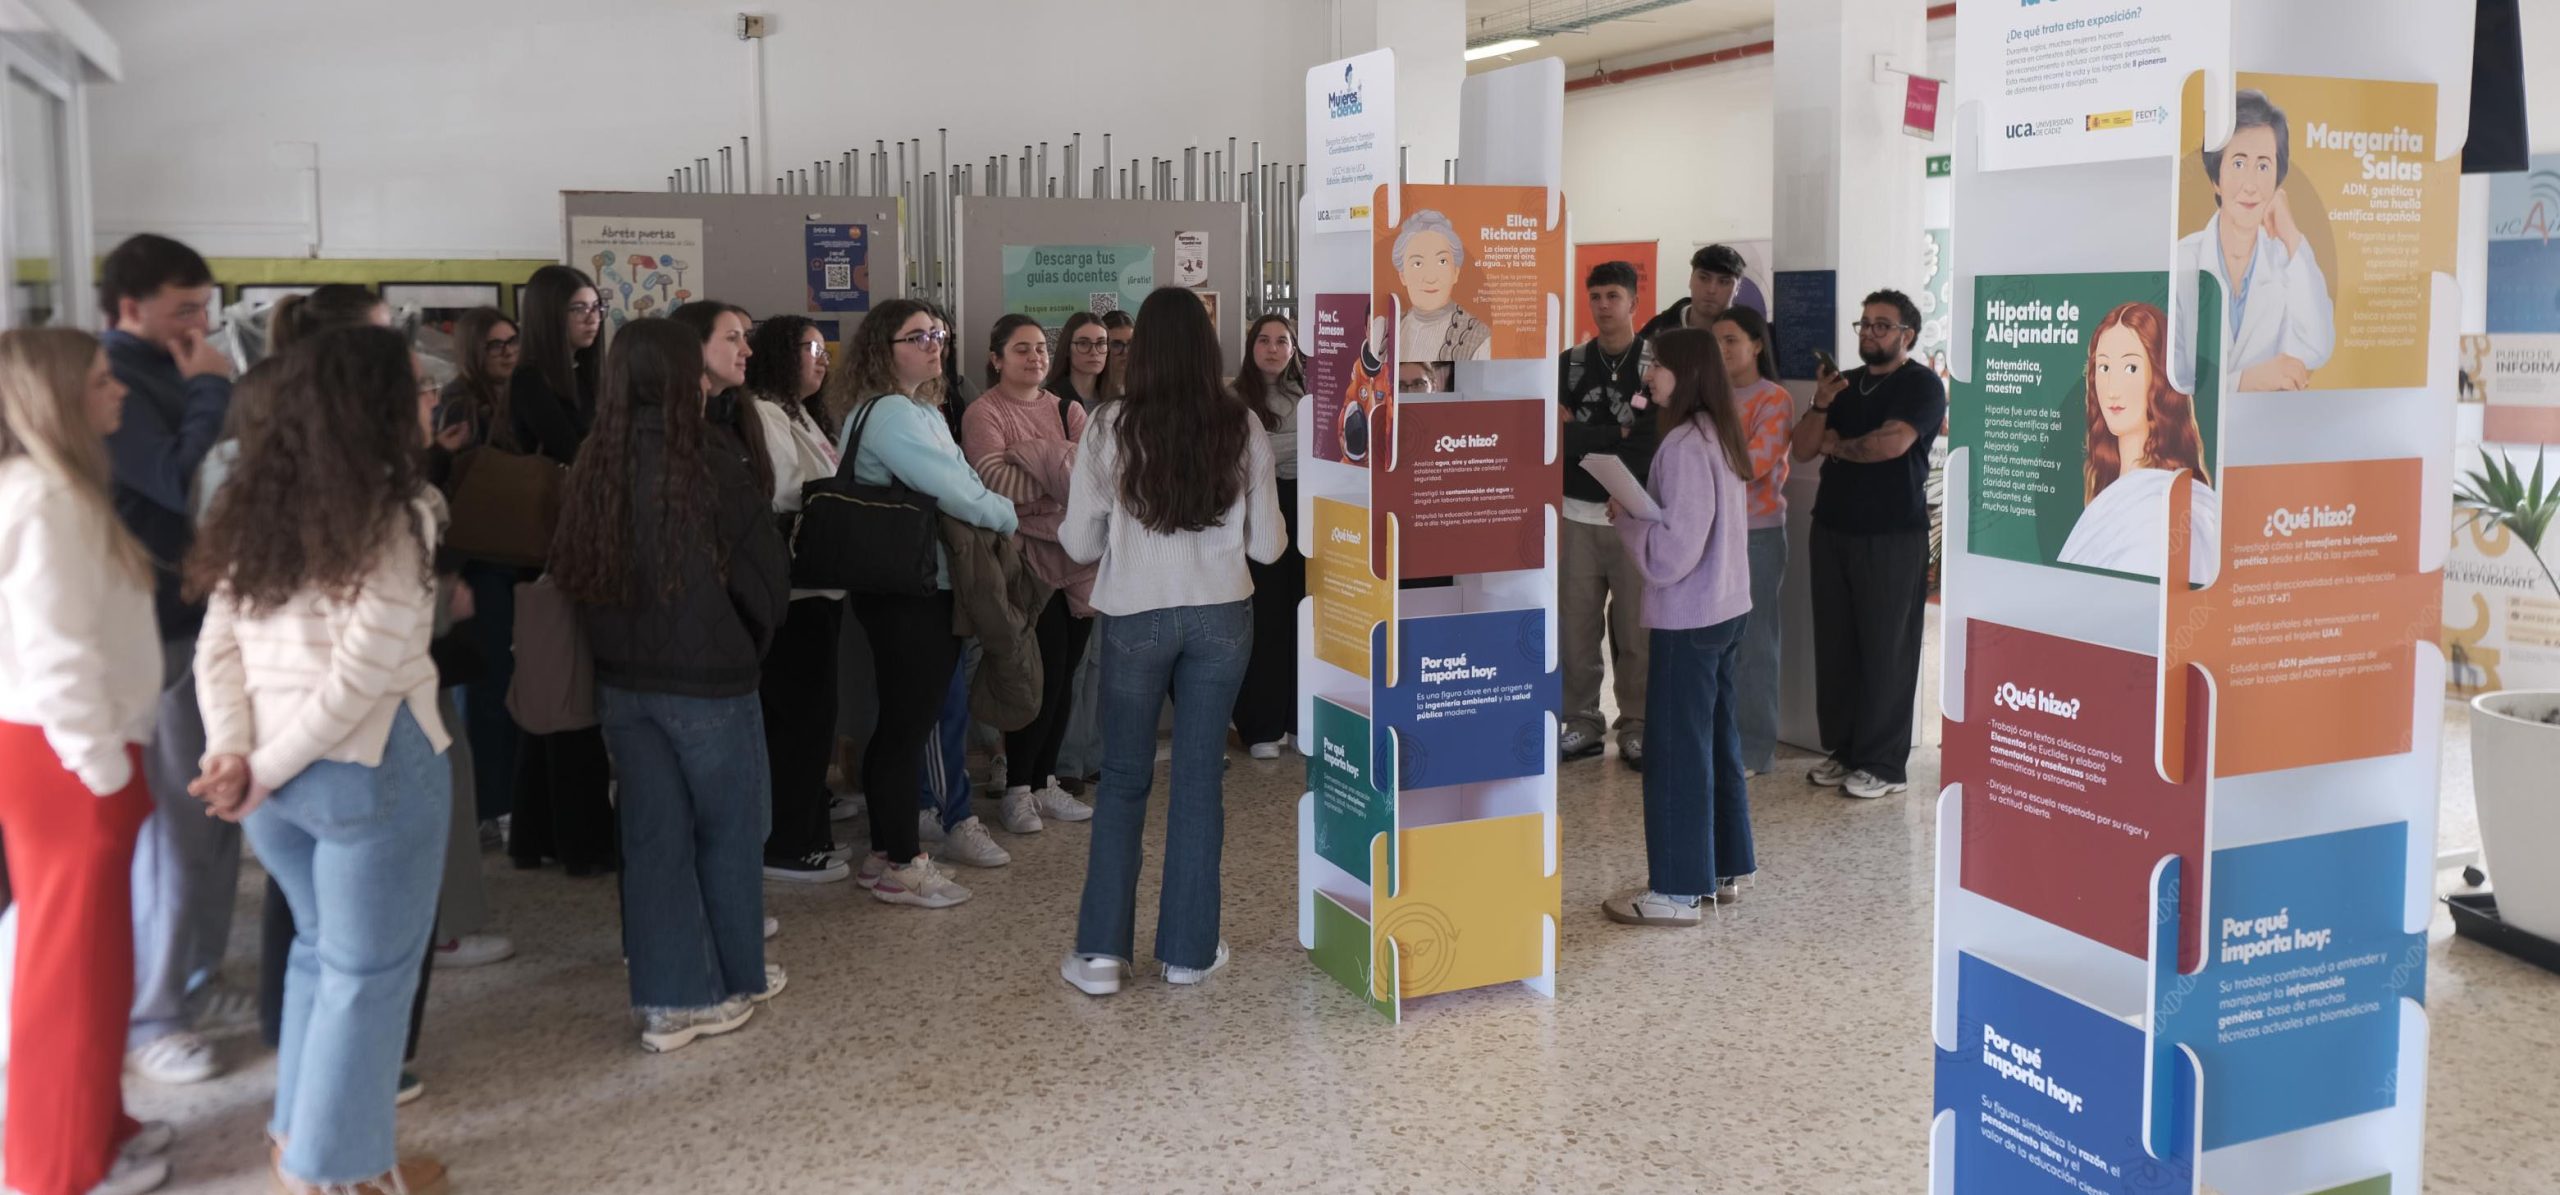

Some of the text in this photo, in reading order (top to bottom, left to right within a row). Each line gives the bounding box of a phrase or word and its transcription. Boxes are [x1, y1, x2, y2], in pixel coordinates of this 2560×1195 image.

[2006, 7, 2142, 43] ¿De qué trata esta exposición?
[1328, 90, 1358, 108] Mujeres
[2036, 118, 2074, 128] UNIVERSIDAD
[2136, 110, 2157, 120] FECYT
[2306, 122, 2423, 157] Margarita
[2362, 154, 2422, 181] Salas
[2342, 183, 2421, 198] ADN, genética y
[2370, 198, 2421, 209] una huella
[1506, 214, 1537, 227] Ellen
[2328, 209, 2421, 224] científica española
[602, 225, 676, 240] Ábrete puertas
[1481, 228, 1537, 240] Richards
[1036, 251, 1115, 268] Descarga tus
[1520, 247, 1536, 255] para
[1027, 269, 1118, 287] guías docentes
[1318, 310, 1339, 322] Mae C.
[1987, 299, 2079, 326] Hipatia de
[1985, 322, 2079, 348] Alejandría
[2496, 351, 2534, 360] PUNTO
[1986, 358, 2042, 373] Matemática,
[1986, 371, 2042, 386] astrónoma y
[1986, 383, 2022, 394] maestra
[1985, 405, 2009, 415] Hipatia
[2012, 405, 2022, 416] fue
[2039, 408, 2048, 417] de
[2050, 409, 2060, 418] las
[1434, 434, 1498, 452] ¿Qué hizo?
[2263, 504, 2356, 537] ¿Qué hizo?
[2463, 572, 2536, 590] ESTUDIANTE
[1422, 653, 1466, 669] Por qué
[1421, 666, 1496, 684] importa hoy:
[1417, 693, 1424, 701] Es
[1441, 691, 1462, 700] figura
[1483, 686, 1491, 694] en
[1500, 685, 1522, 694] origen
[1994, 682, 2080, 720] ¿Qué hizo?
[1425, 699, 1460, 710] ingeniería
[1462, 696, 1497, 706] ambiental
[1417, 708, 1477, 721] pública moderna.
[1324, 737, 1344, 758] Por qué
[1991, 732, 2106, 772] Elementos de Euclides y elaboró
[2019, 728, 2032, 739] con
[2034, 731, 2055, 745] textos
[2057, 738, 2086, 754] clásicos
[2087, 746, 2110, 760] como
[2111, 751, 2123, 764] los
[1324, 749, 1346, 769] importa
[1990, 745, 2107, 786] comentarios y enseñanzas sobre
[1990, 757, 2086, 792] matemáticas y astronomía.
[2013, 788, 2027, 800] una
[2029, 793, 2056, 808] escuela
[2058, 801, 2096, 821] respetada
[2097, 815, 2111, 825] por
[2112, 818, 2121, 829] su
[2123, 821, 2142, 836] rigor
[2144, 829, 2149, 839] y
[2222, 907, 2288, 940] Por qué
[2221, 928, 2331, 965] importa hoy:
[2219, 952, 2387, 994] Su trabajo contribuyó a entender y
[2219, 977, 2345, 1010] manipular la información
[1984, 1024, 2042, 1069] Por qué
[1983, 1045, 2083, 1114] importa hoy:
[1981, 1095, 2120, 1178] Su figura simboliza la razón, el
[1981, 1112, 2080, 1172] pensamiento libre y el
